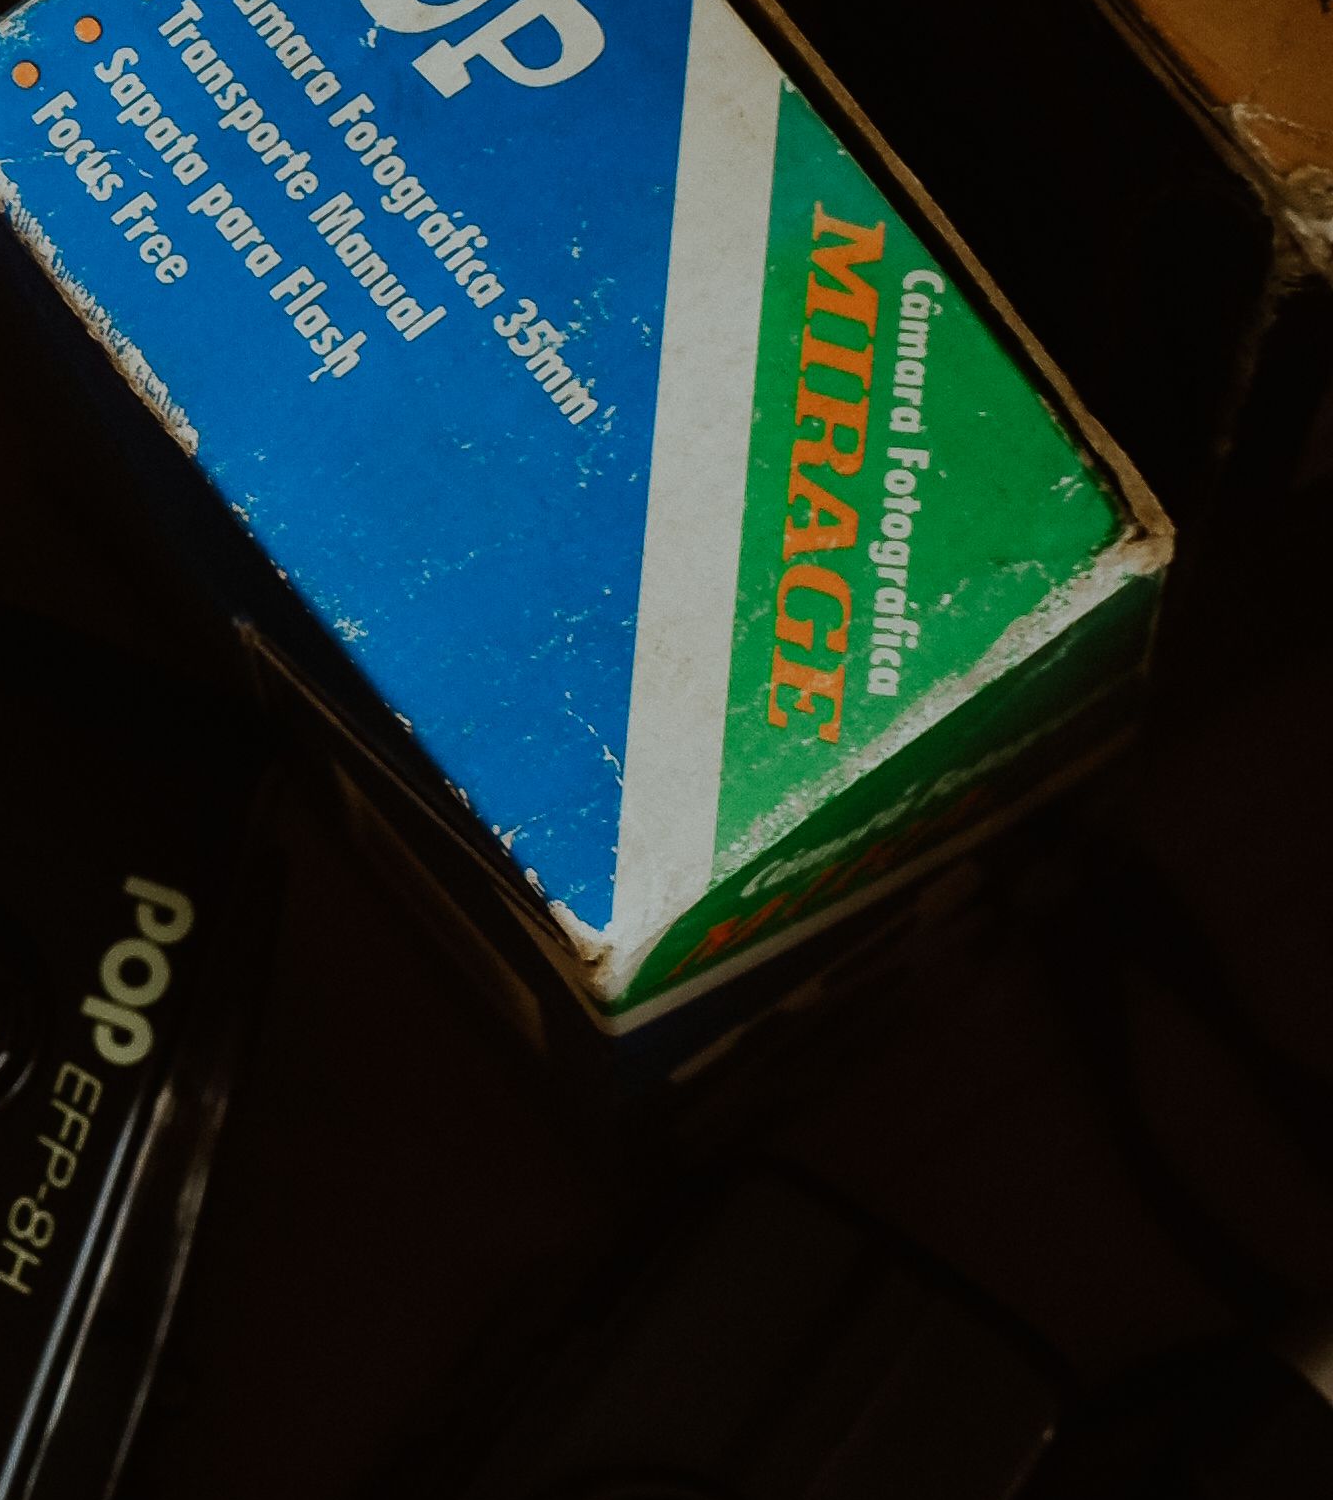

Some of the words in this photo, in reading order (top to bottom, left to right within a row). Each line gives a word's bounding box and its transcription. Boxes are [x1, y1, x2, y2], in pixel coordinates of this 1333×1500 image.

[31, 88, 126, 203] Focus
[109, 192, 189, 287] Free
[93, 45, 210, 186] Sapata
[186, 181, 284, 285] para
[269, 264, 371, 383] Flash
[308, 192, 449, 342] Manual
[327, 91, 506, 309] Fotográfica
[493, 298, 601, 428] 35mm
[887, 267, 945, 434] Cámara
[766, 200, 887, 746] MIRAGE
[865, 446, 931, 700] Fotográfica
[80, 874, 196, 1067] POP
